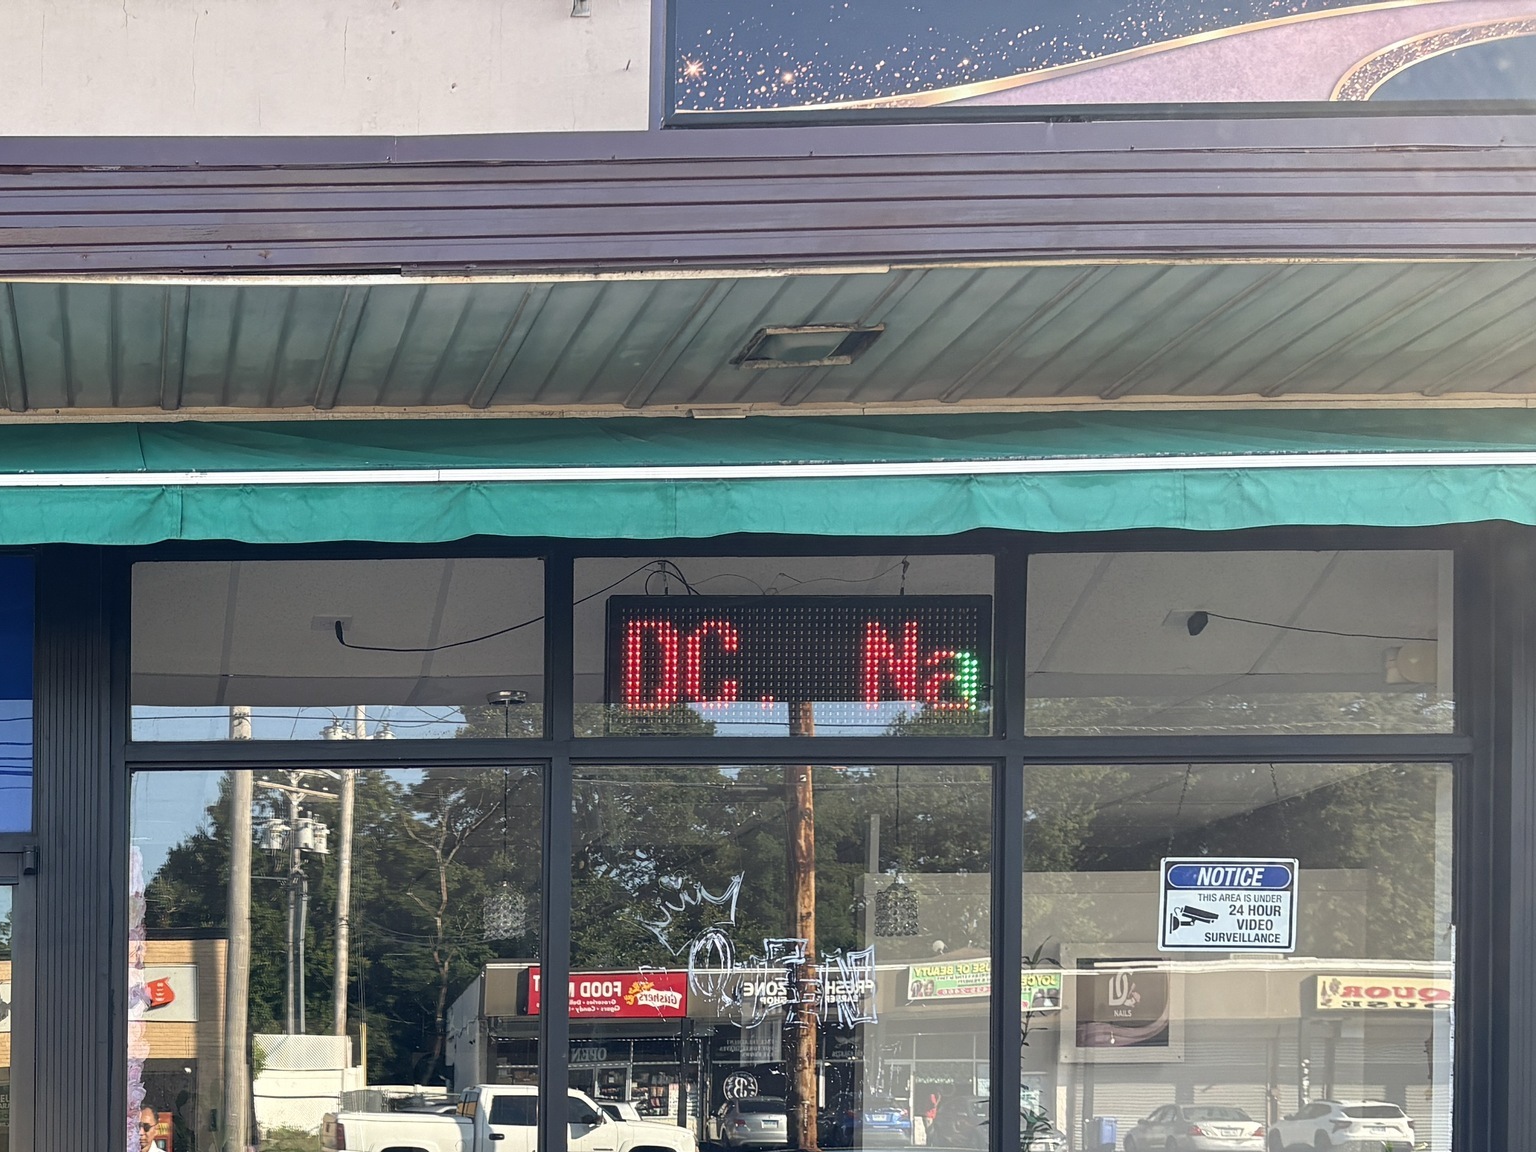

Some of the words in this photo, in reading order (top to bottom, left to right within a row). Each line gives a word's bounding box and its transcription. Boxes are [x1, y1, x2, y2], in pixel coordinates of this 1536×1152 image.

[1197, 867, 1265, 887] NOTICE
[1198, 893, 1217, 902] THIS
[1219, 893, 1241, 903] AREA
[1244, 894, 1252, 903] IS
[1253, 894, 1282, 903] UNDER
[1229, 904, 1244, 916] 24
[1248, 905, 1281, 917] HOUR
[1237, 918, 1273, 931] VIDEO
[1204, 932, 1281, 943] SURVEILLANCE
[1114, 1009, 1132, 1017] NAILS
